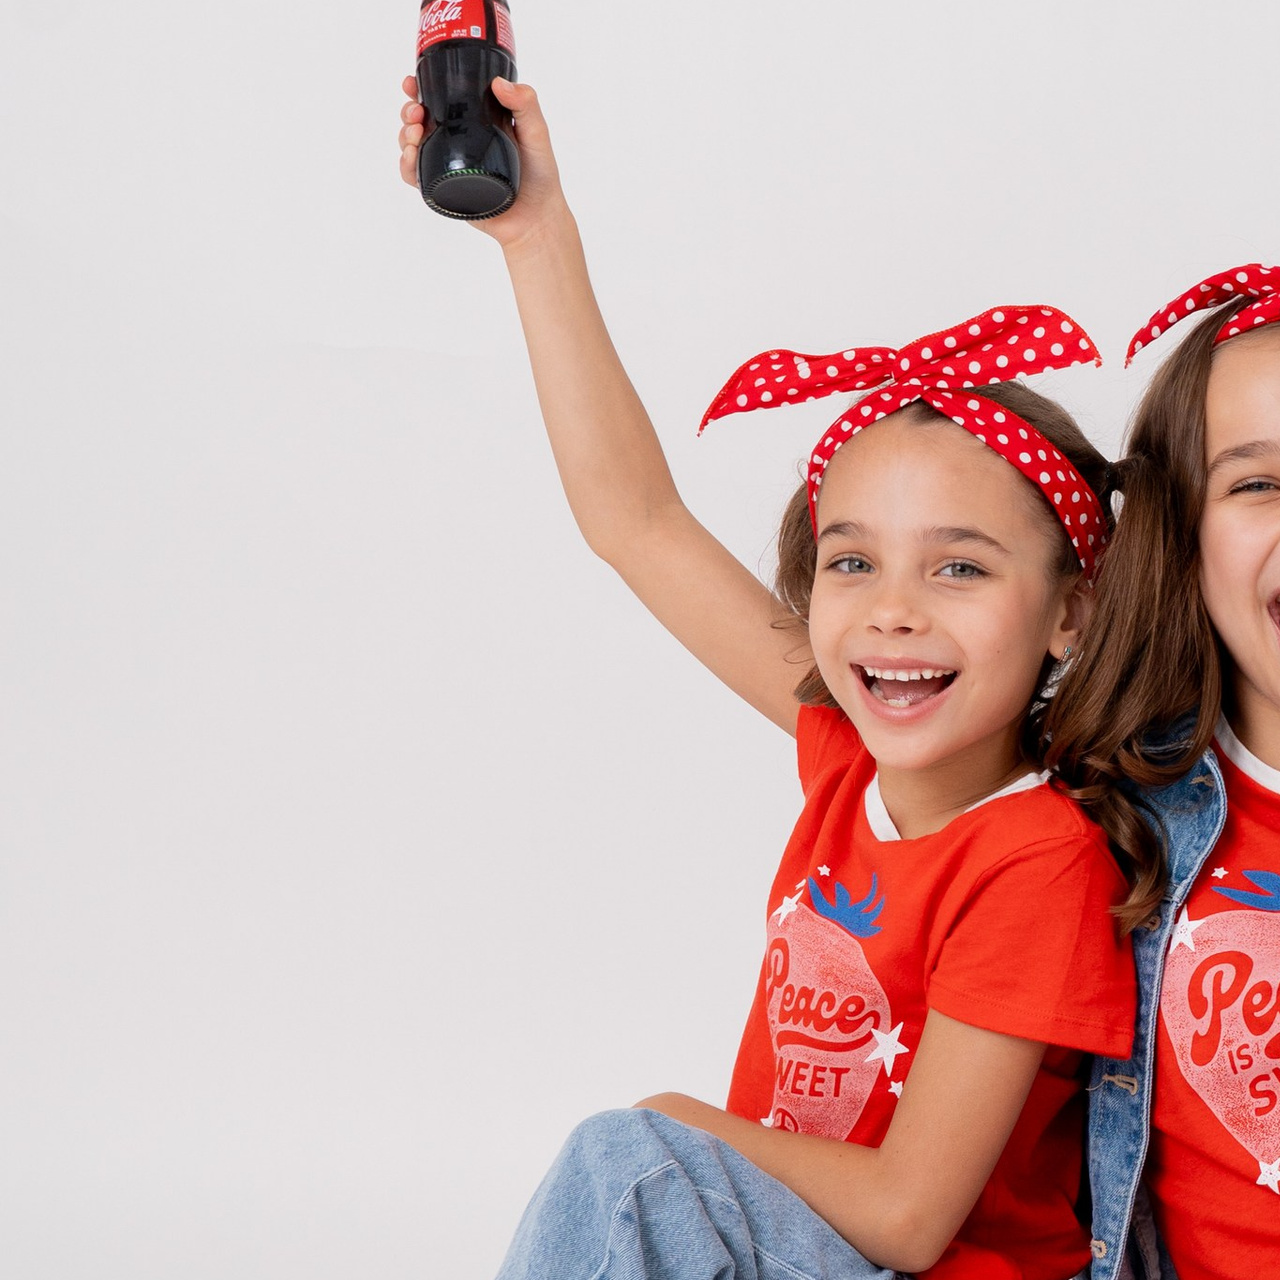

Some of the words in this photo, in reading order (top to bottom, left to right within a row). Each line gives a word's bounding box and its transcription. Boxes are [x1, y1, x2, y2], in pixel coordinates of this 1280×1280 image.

[767, 937, 880, 1053] Peace
[776, 1056, 851, 1098] WEET
[1228, 1047, 1251, 1075] IS
